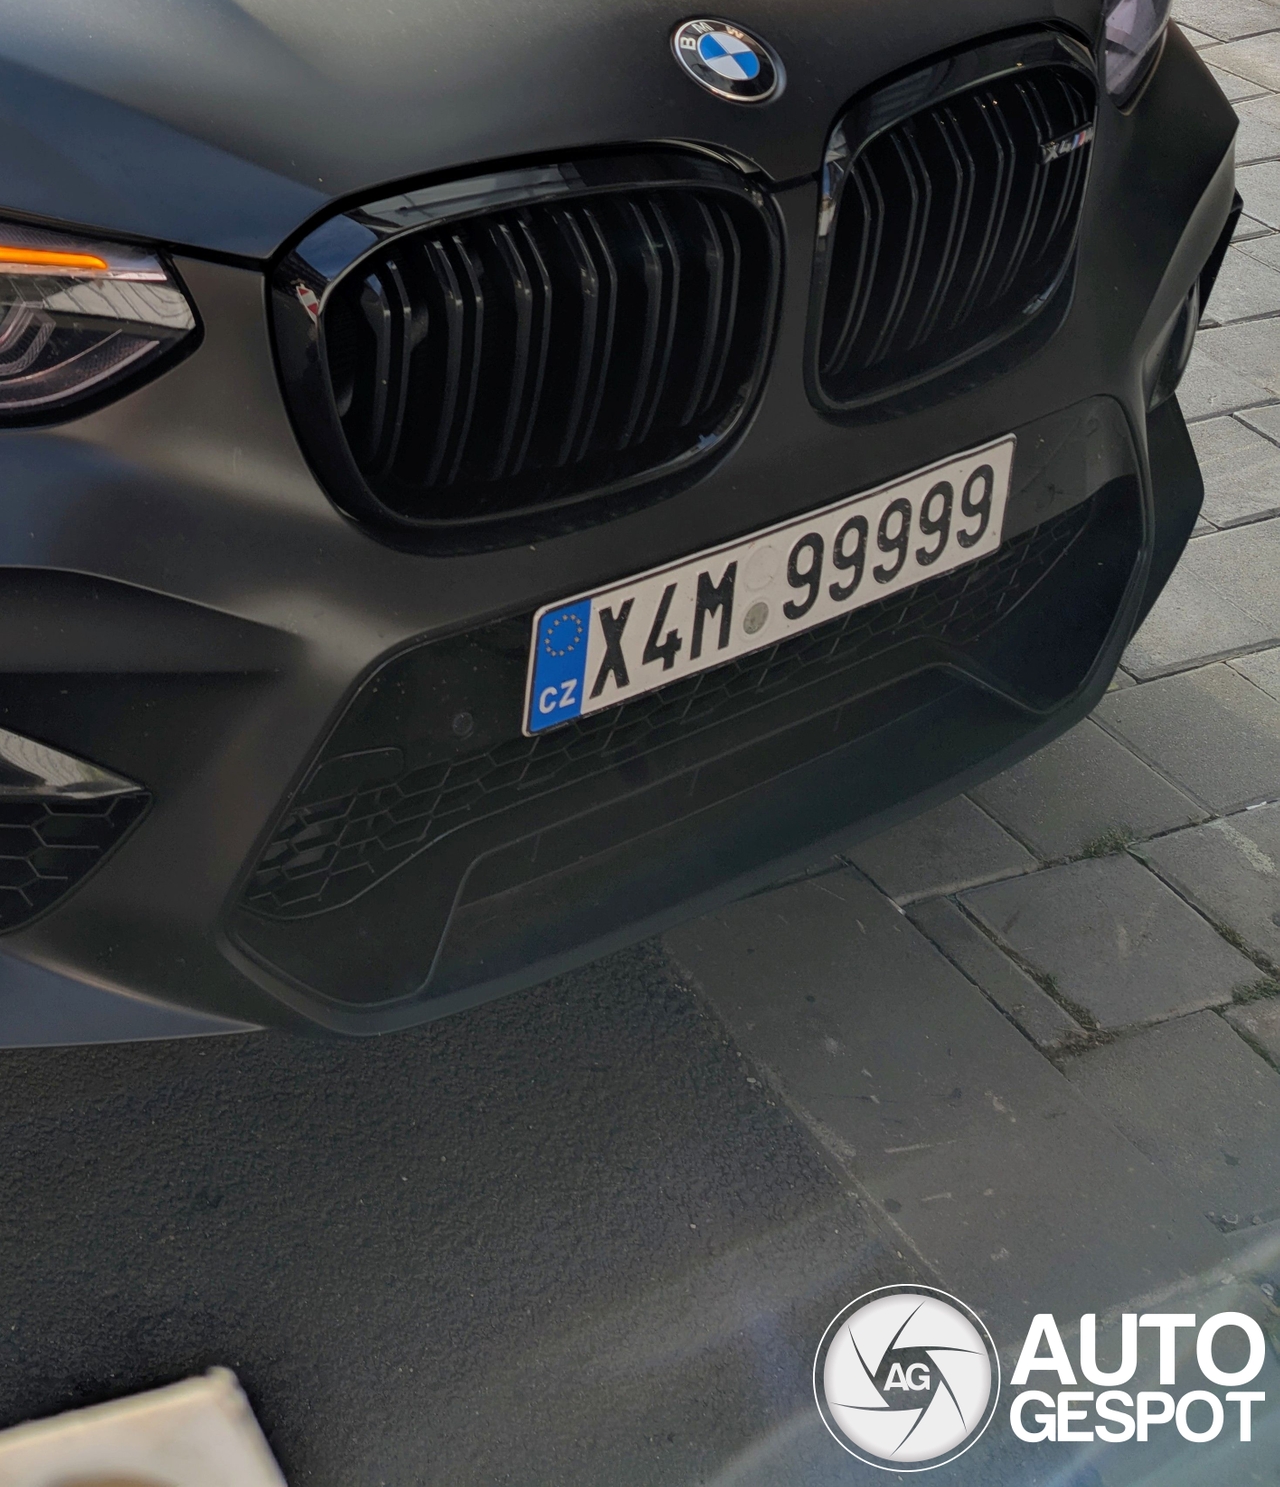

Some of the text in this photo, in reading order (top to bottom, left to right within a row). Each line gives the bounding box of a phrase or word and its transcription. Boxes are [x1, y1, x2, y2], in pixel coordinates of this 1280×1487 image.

[680, 21, 744, 51] BMW
[589, 464, 995, 699] X4M 99999
[538, 678, 579, 714] CZ
